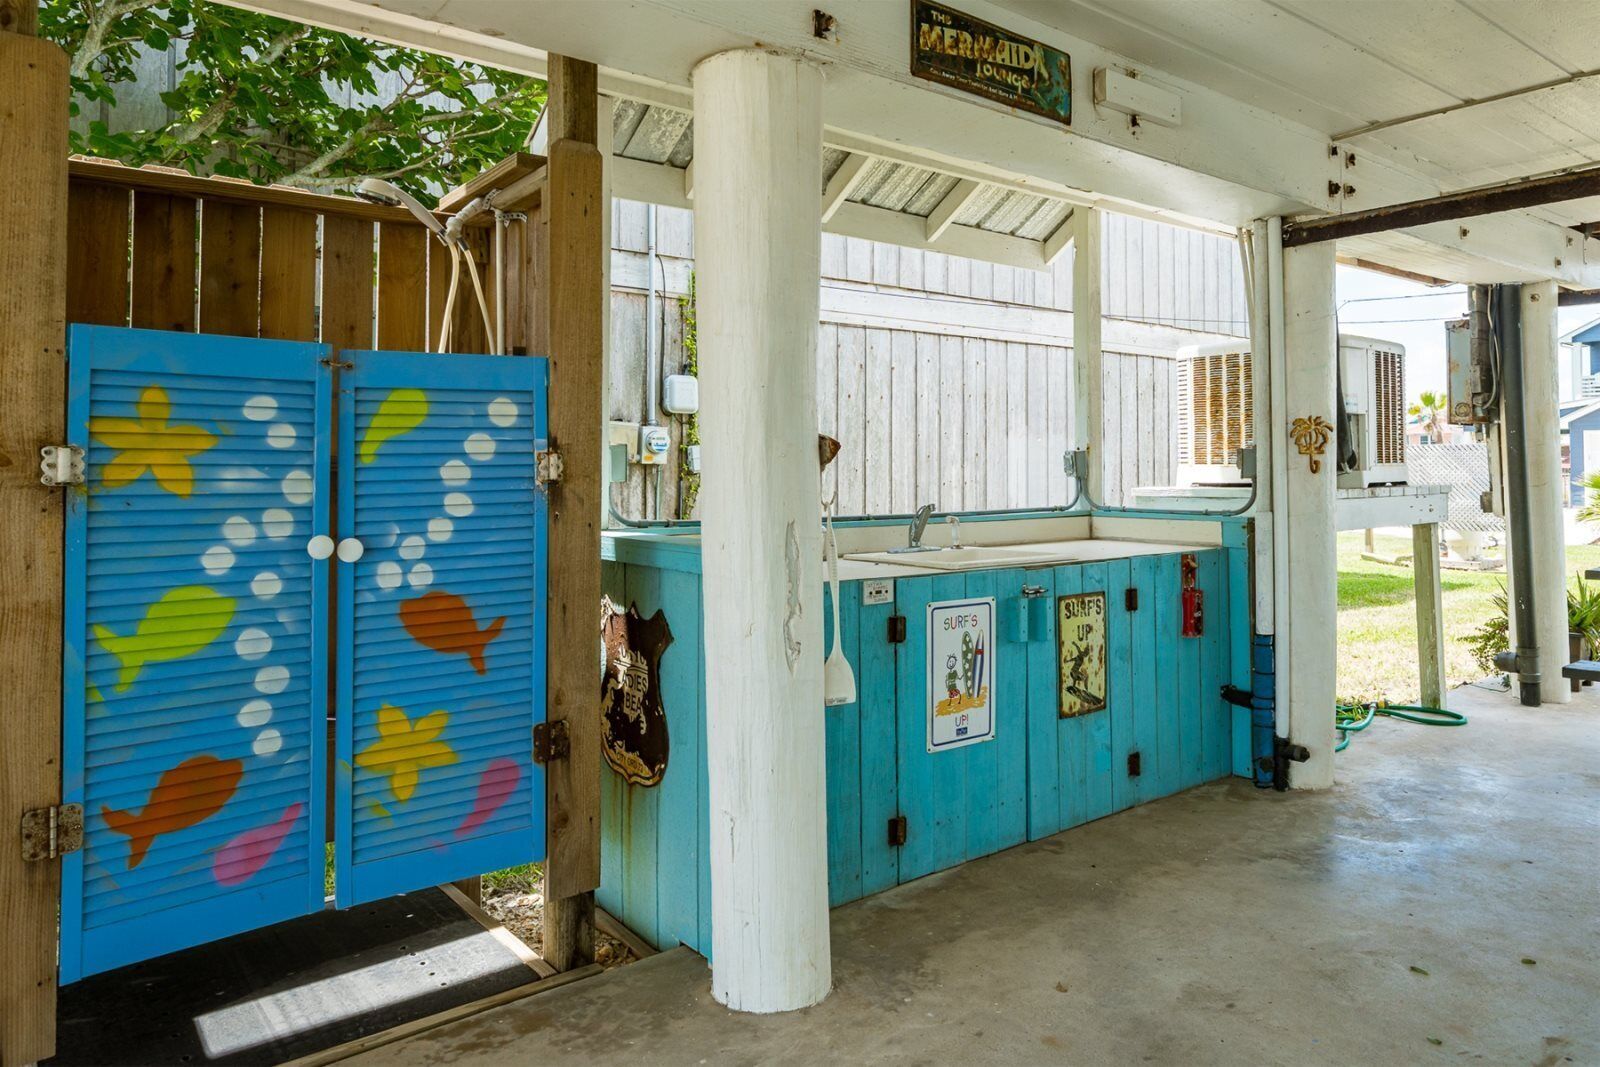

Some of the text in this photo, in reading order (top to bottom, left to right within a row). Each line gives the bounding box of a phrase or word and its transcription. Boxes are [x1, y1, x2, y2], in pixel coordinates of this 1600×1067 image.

[919, 22, 1034, 70] MERMAID
[1064, 598, 1102, 620] SURF'S
[943, 614, 978, 631] SURF'S
[1077, 623, 1093, 642] UP
[622, 673, 648, 694] ADIES
[624, 693, 643, 714] BEA
[955, 714, 969, 728] UP!
